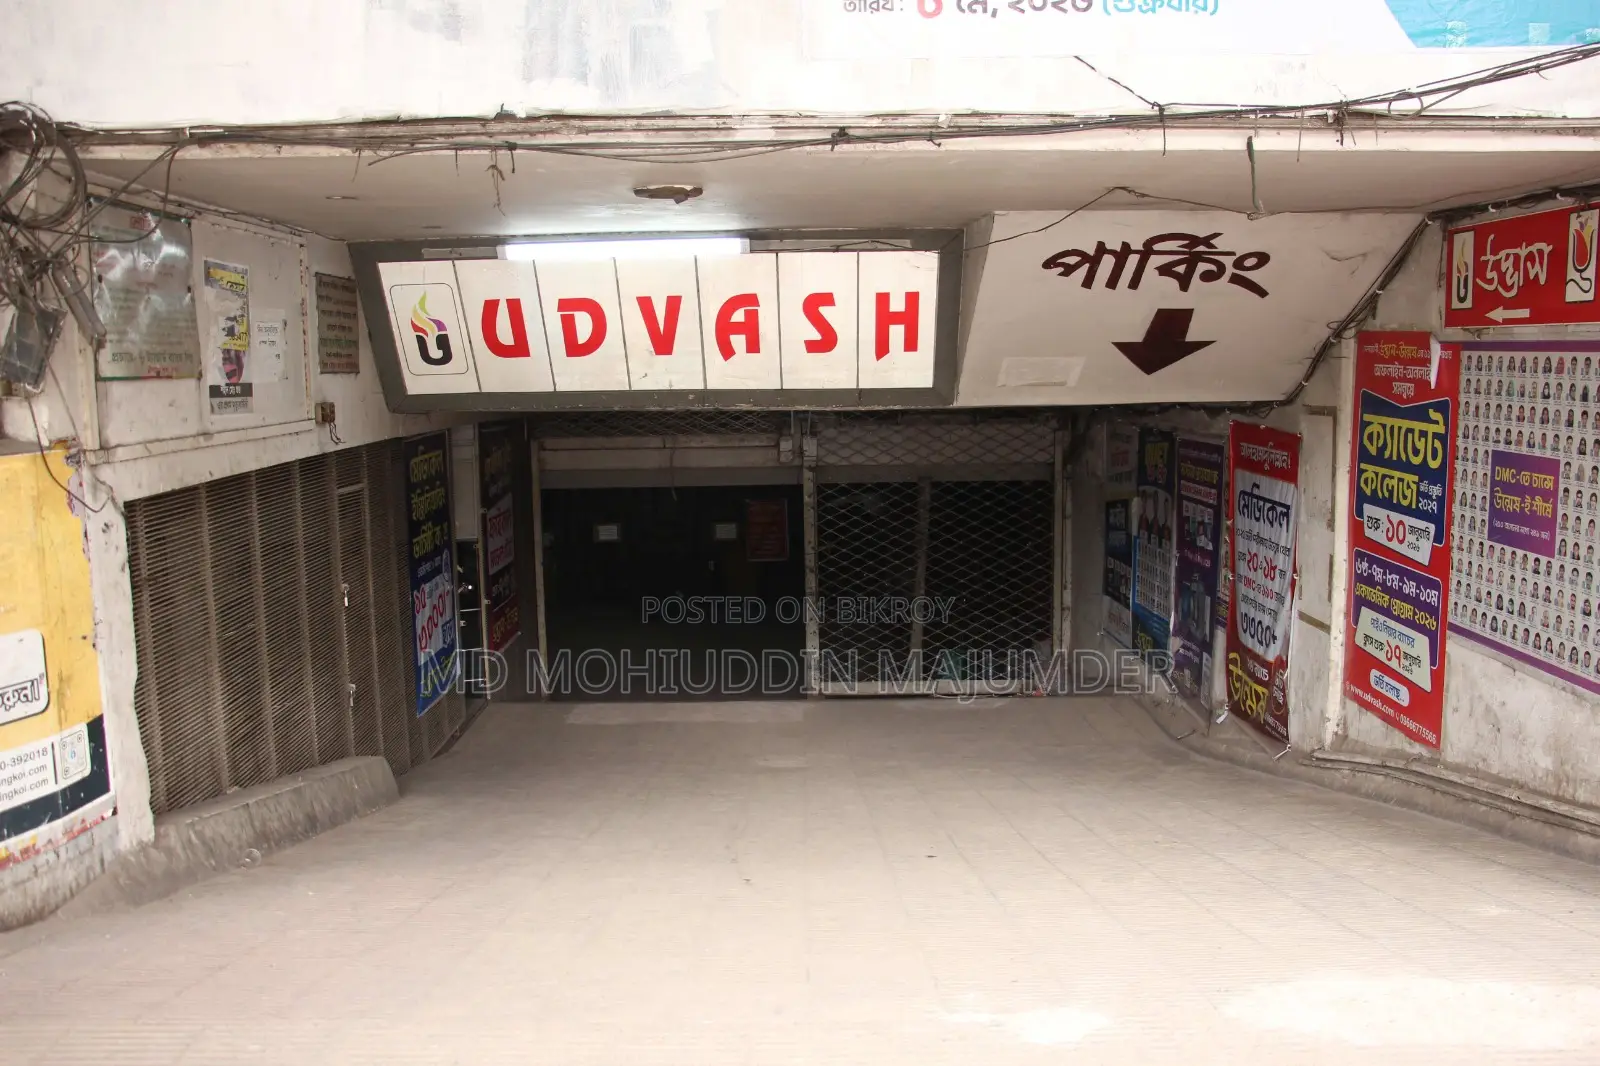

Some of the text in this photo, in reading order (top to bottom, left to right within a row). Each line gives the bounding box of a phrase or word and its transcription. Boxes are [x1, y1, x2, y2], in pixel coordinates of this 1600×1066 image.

[1042, 232, 1271, 298] পার্কিং
[1476, 234, 1553, 298] উদ্ভাস
[481, 291, 920, 362] UDVASH
[1374, 362, 1432, 382] অফলাইন-অনলাই
[1362, 408, 1446, 469] ক্যাডেট
[1359, 463, 1419, 509] কলেজ
[1495, 466, 1531, 486] DMC-তে
[1238, 482, 1291, 533] মেডিকেল
[1418, 497, 1438, 514] ২০২৭
[1494, 487, 1531, 515] উন্মেষ-ই
[1385, 514, 1407, 545] ১০
[1407, 524, 1431, 542] জানুয়ারি
[1247, 548, 1259, 573] ২০
[1263, 555, 1278, 582] ১৮
[1241, 611, 1278, 648] ৩৩৫০+
[1414, 608, 1437, 631] ২০২৬
[1385, 640, 1402, 669] ১৭
[0, 678, 40, 711] রুন।
[1350, 684, 1395, 717] www.udvash.com
[0, 763, 48, 787] ngkoi.com
